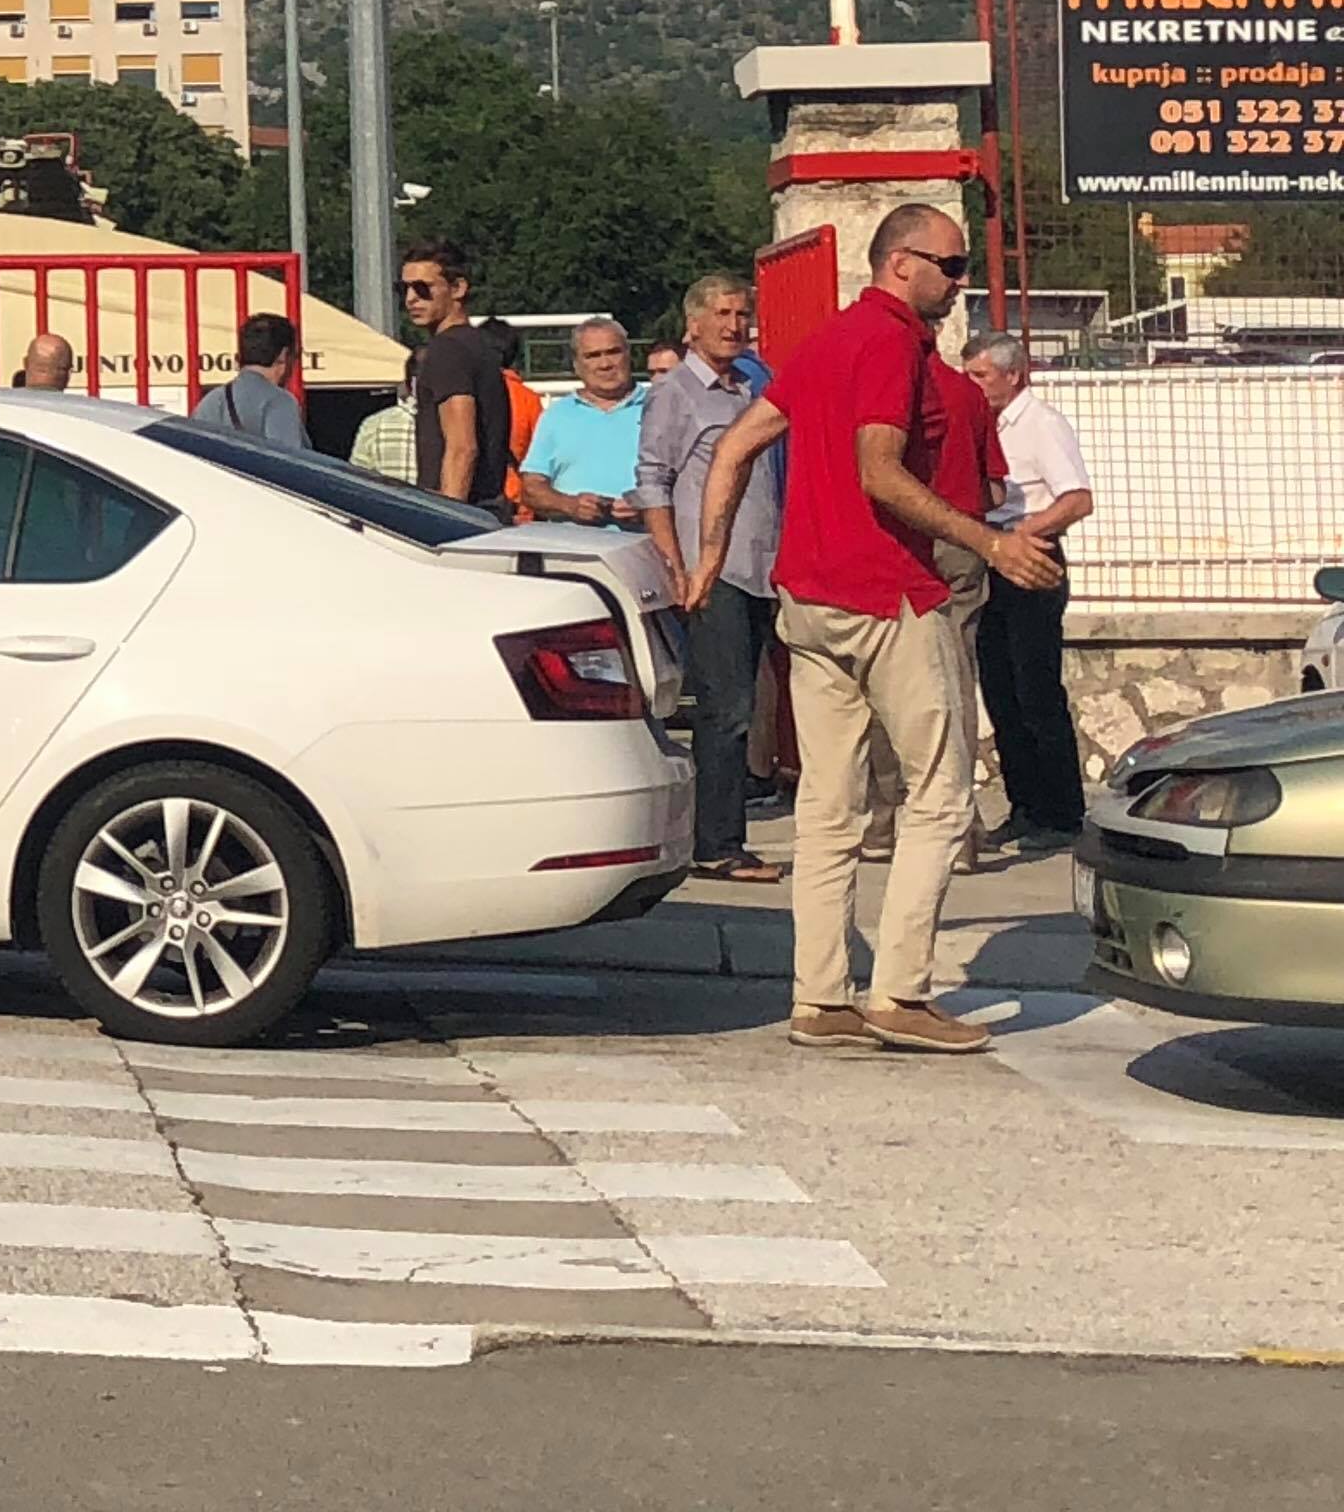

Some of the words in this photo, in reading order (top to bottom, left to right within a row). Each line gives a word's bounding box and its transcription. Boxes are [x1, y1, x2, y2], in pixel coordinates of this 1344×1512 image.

[1081, 19, 1318, 43] NEKRETNINE
[1092, 62, 1187, 88] kupnja
[1221, 62, 1326, 88] prodaja
[1160, 99, 1221, 123] 051
[1236, 99, 1302, 123] 322
[1150, 130, 1211, 153] 091
[1227, 130, 1292, 153] 322
[1303, 130, 1344, 153] 37
[1077, 169, 1344, 193] www.millennium-nek
